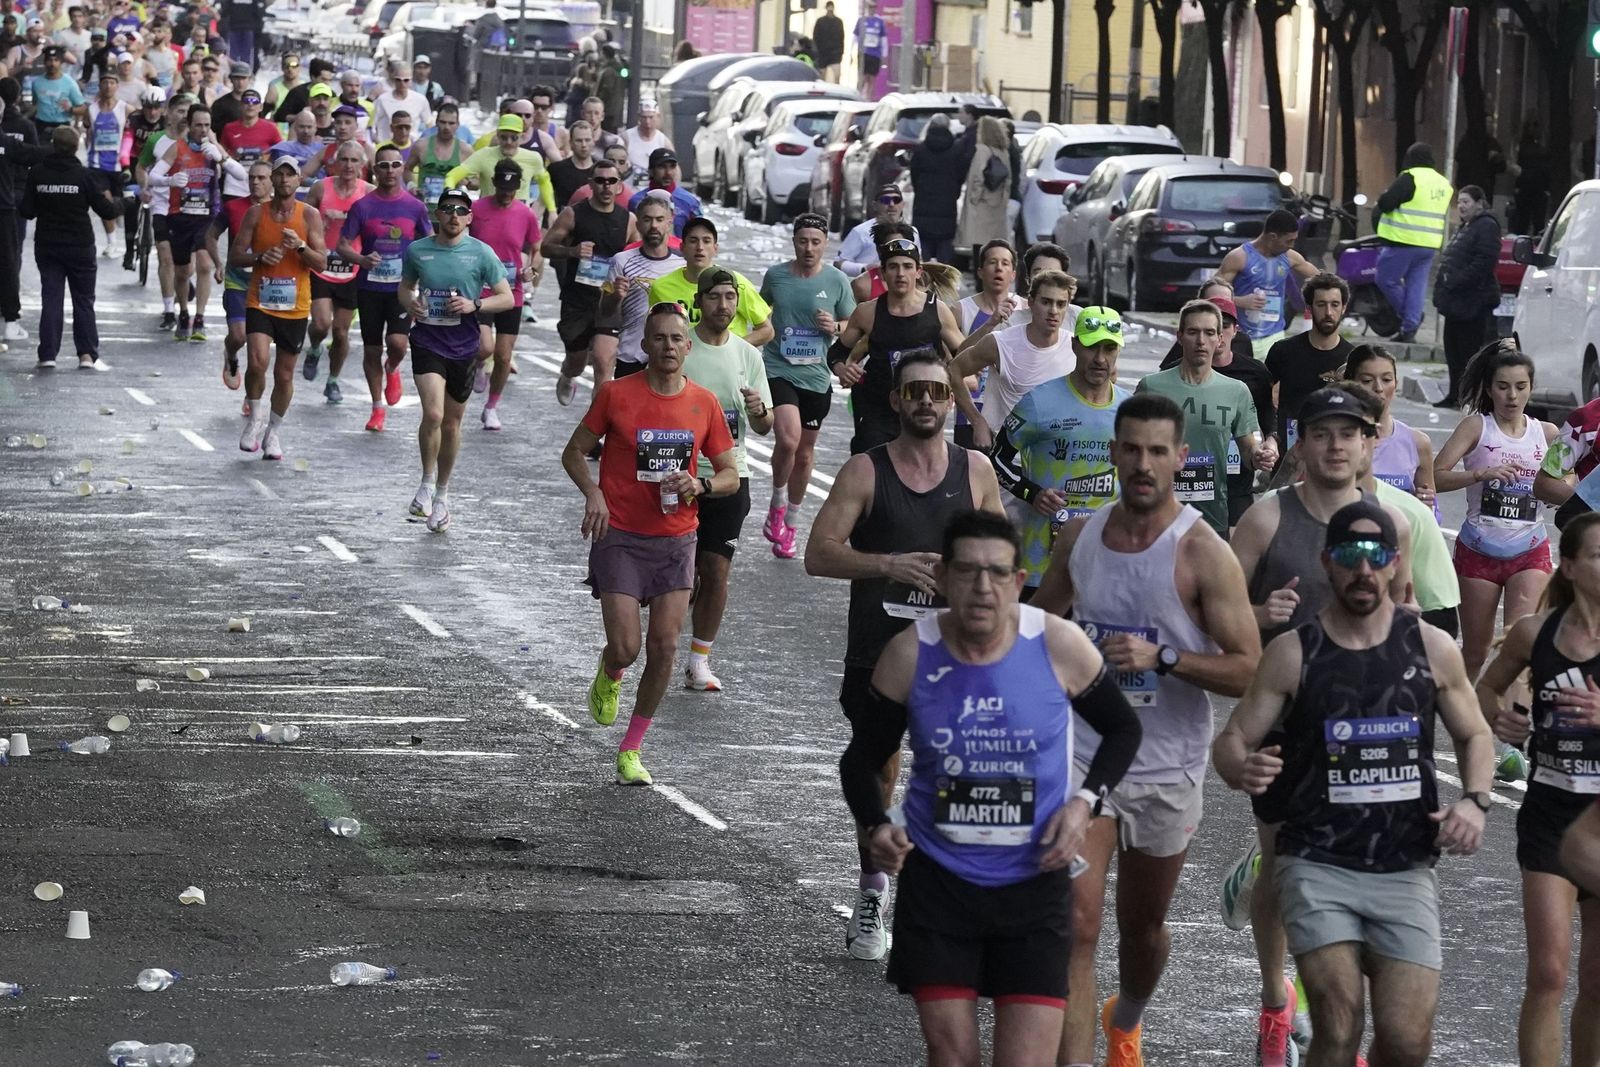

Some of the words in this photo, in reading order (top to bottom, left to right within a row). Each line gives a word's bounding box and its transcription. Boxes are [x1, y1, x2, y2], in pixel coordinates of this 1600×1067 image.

[37, 185, 79, 193] VOLUNTEER
[786, 347, 817, 356] DAMIEN
[657, 432, 689, 440] ZURICH
[658, 448, 675, 456] 4727
[1066, 474, 1113, 492] FINISHER
[1194, 481, 1214, 490] BSVR
[1383, 478, 1404, 486] RICH
[1499, 506, 1520, 518] ITXI
[1115, 671, 1145, 687] RIS
[977, 697, 1003, 711] ACJ
[1358, 722, 1410, 735] ZURICH
[964, 740, 1037, 756] JUMILLA
[1360, 748, 1389, 760] 5205
[968, 761, 1025, 773] ZURICH
[1328, 769, 1346, 784] EL
[1349, 765, 1421, 783] CAPILLITA
[969, 787, 1000, 800] 4772
[949, 801, 1021, 823] MARTÍN
